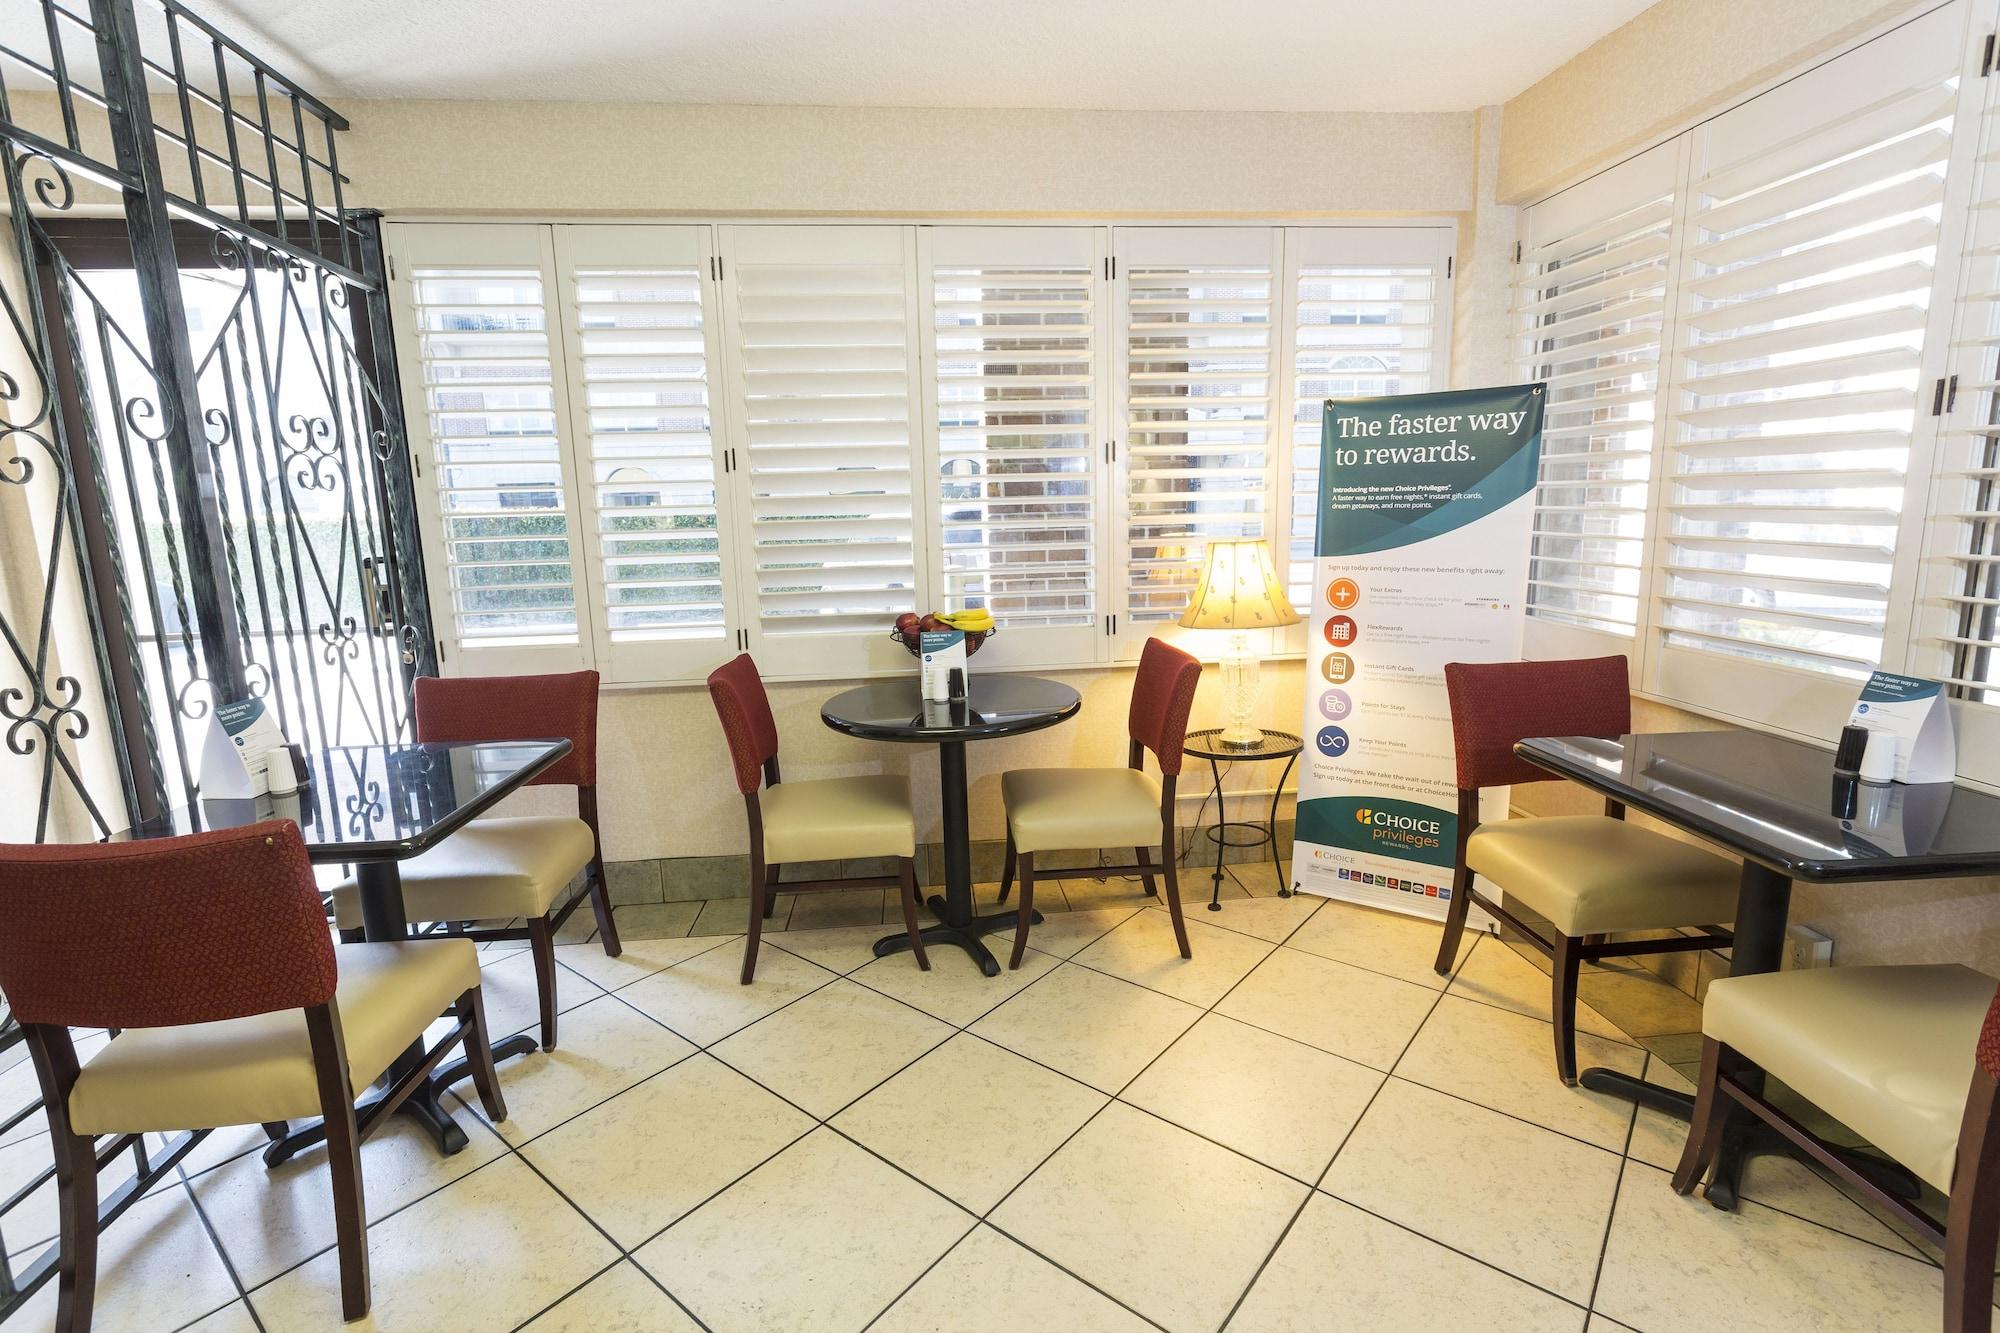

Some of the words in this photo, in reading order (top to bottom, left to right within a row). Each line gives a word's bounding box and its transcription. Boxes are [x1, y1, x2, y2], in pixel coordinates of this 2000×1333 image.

[1336, 416, 1382, 438] The
[1387, 414, 1462, 436] faster
[1468, 410, 1527, 436] way
[1335, 446, 1358, 466] to
[1364, 440, 1476, 465] rewards.
[1452, 492, 1462, 500] gift
[1368, 624, 1403, 632] FlexRewards
[1313, 772, 1326, 780] Sign
[1336, 776, 1353, 784] today
[1374, 812, 1440, 835] CHOICE
[1373, 828, 1440, 848] privileges
[1324, 852, 1356, 864] CHOICE
